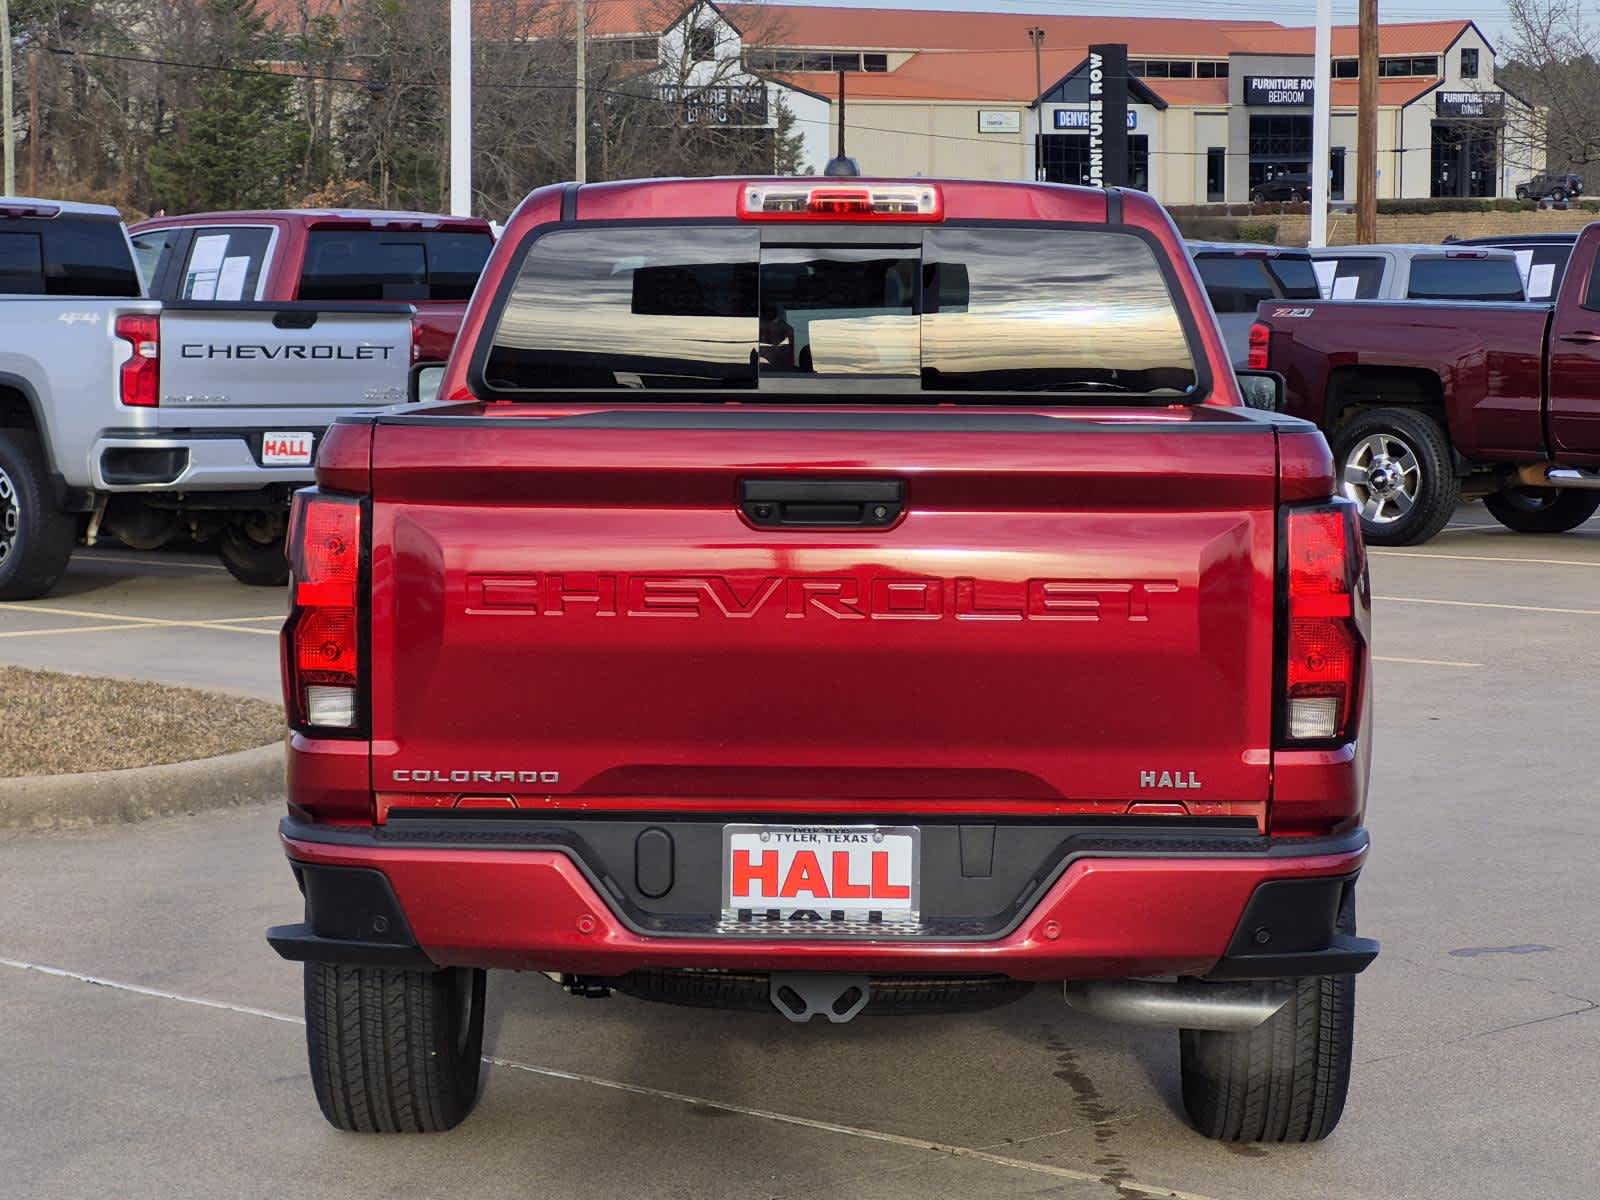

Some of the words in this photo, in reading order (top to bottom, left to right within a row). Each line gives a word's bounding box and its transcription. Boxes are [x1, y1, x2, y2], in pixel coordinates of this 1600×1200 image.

[1090, 53, 1103, 95] ROW
[1252, 79, 1299, 90] FURNITURE
[1301, 79, 1315, 90] RO
[1268, 91, 1304, 103] BEDROOM
[1443, 93, 1483, 103] FURNITURE
[1060, 111, 1090, 126] DENVE
[1090, 100, 1103, 188] URNITURE
[181, 344, 395, 360] CHEVROLET
[264, 440, 309, 456] HALL
[464, 573, 1180, 622] CHEVROLET
[392, 769, 560, 784] COLORADO
[1139, 770, 1202, 789] HALL
[776, 833, 822, 844] TYLER,
[826, 834, 869, 844] TEXAS
[732, 849, 911, 899] HALL
